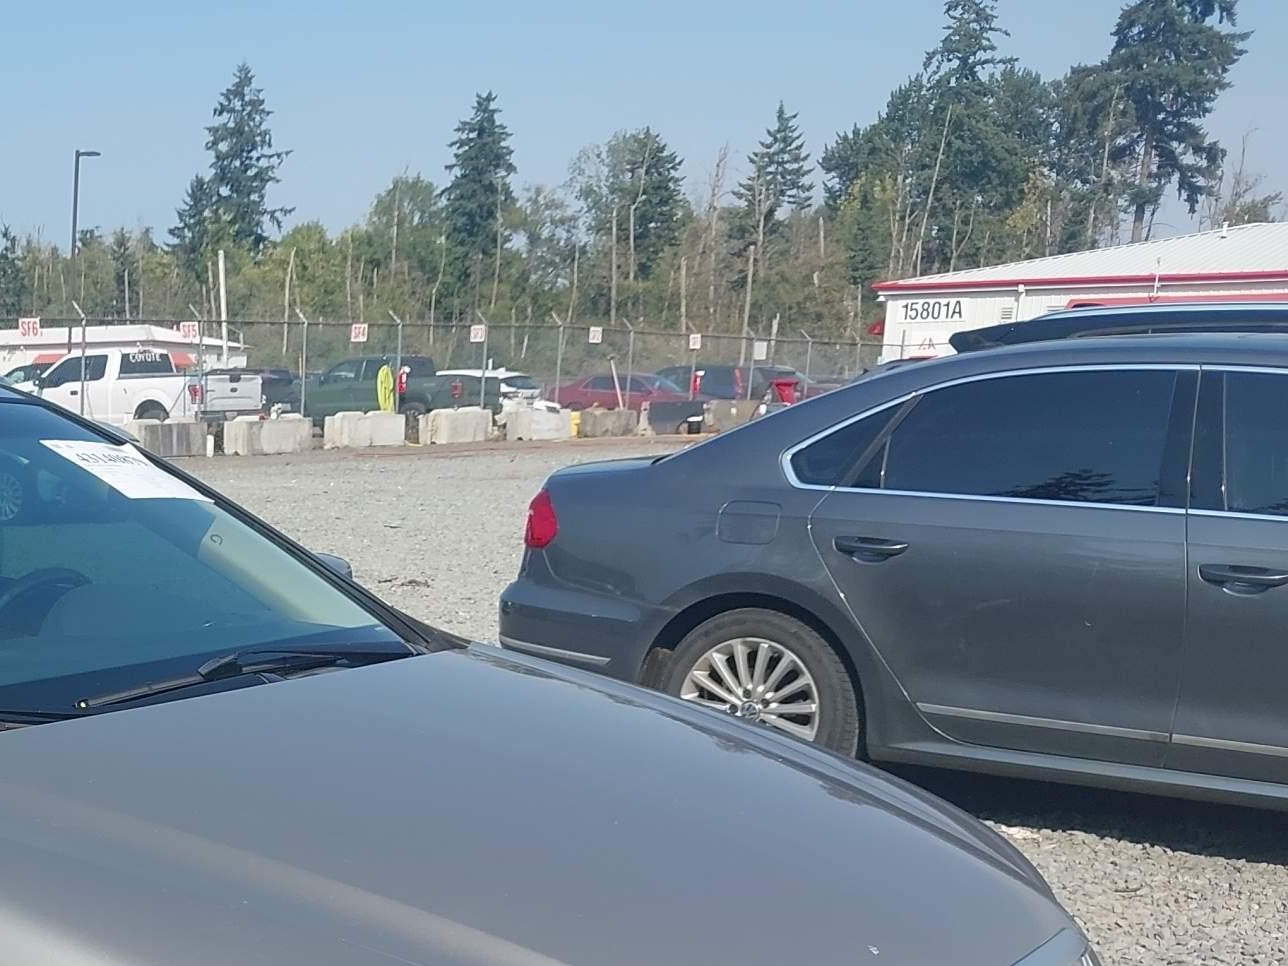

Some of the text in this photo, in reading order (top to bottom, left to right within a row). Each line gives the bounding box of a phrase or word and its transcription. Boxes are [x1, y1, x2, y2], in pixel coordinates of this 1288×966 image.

[901, 300, 963, 320] 15801A
[21, 321, 39, 336] SF6
[182, 324, 198, 338] SF5
